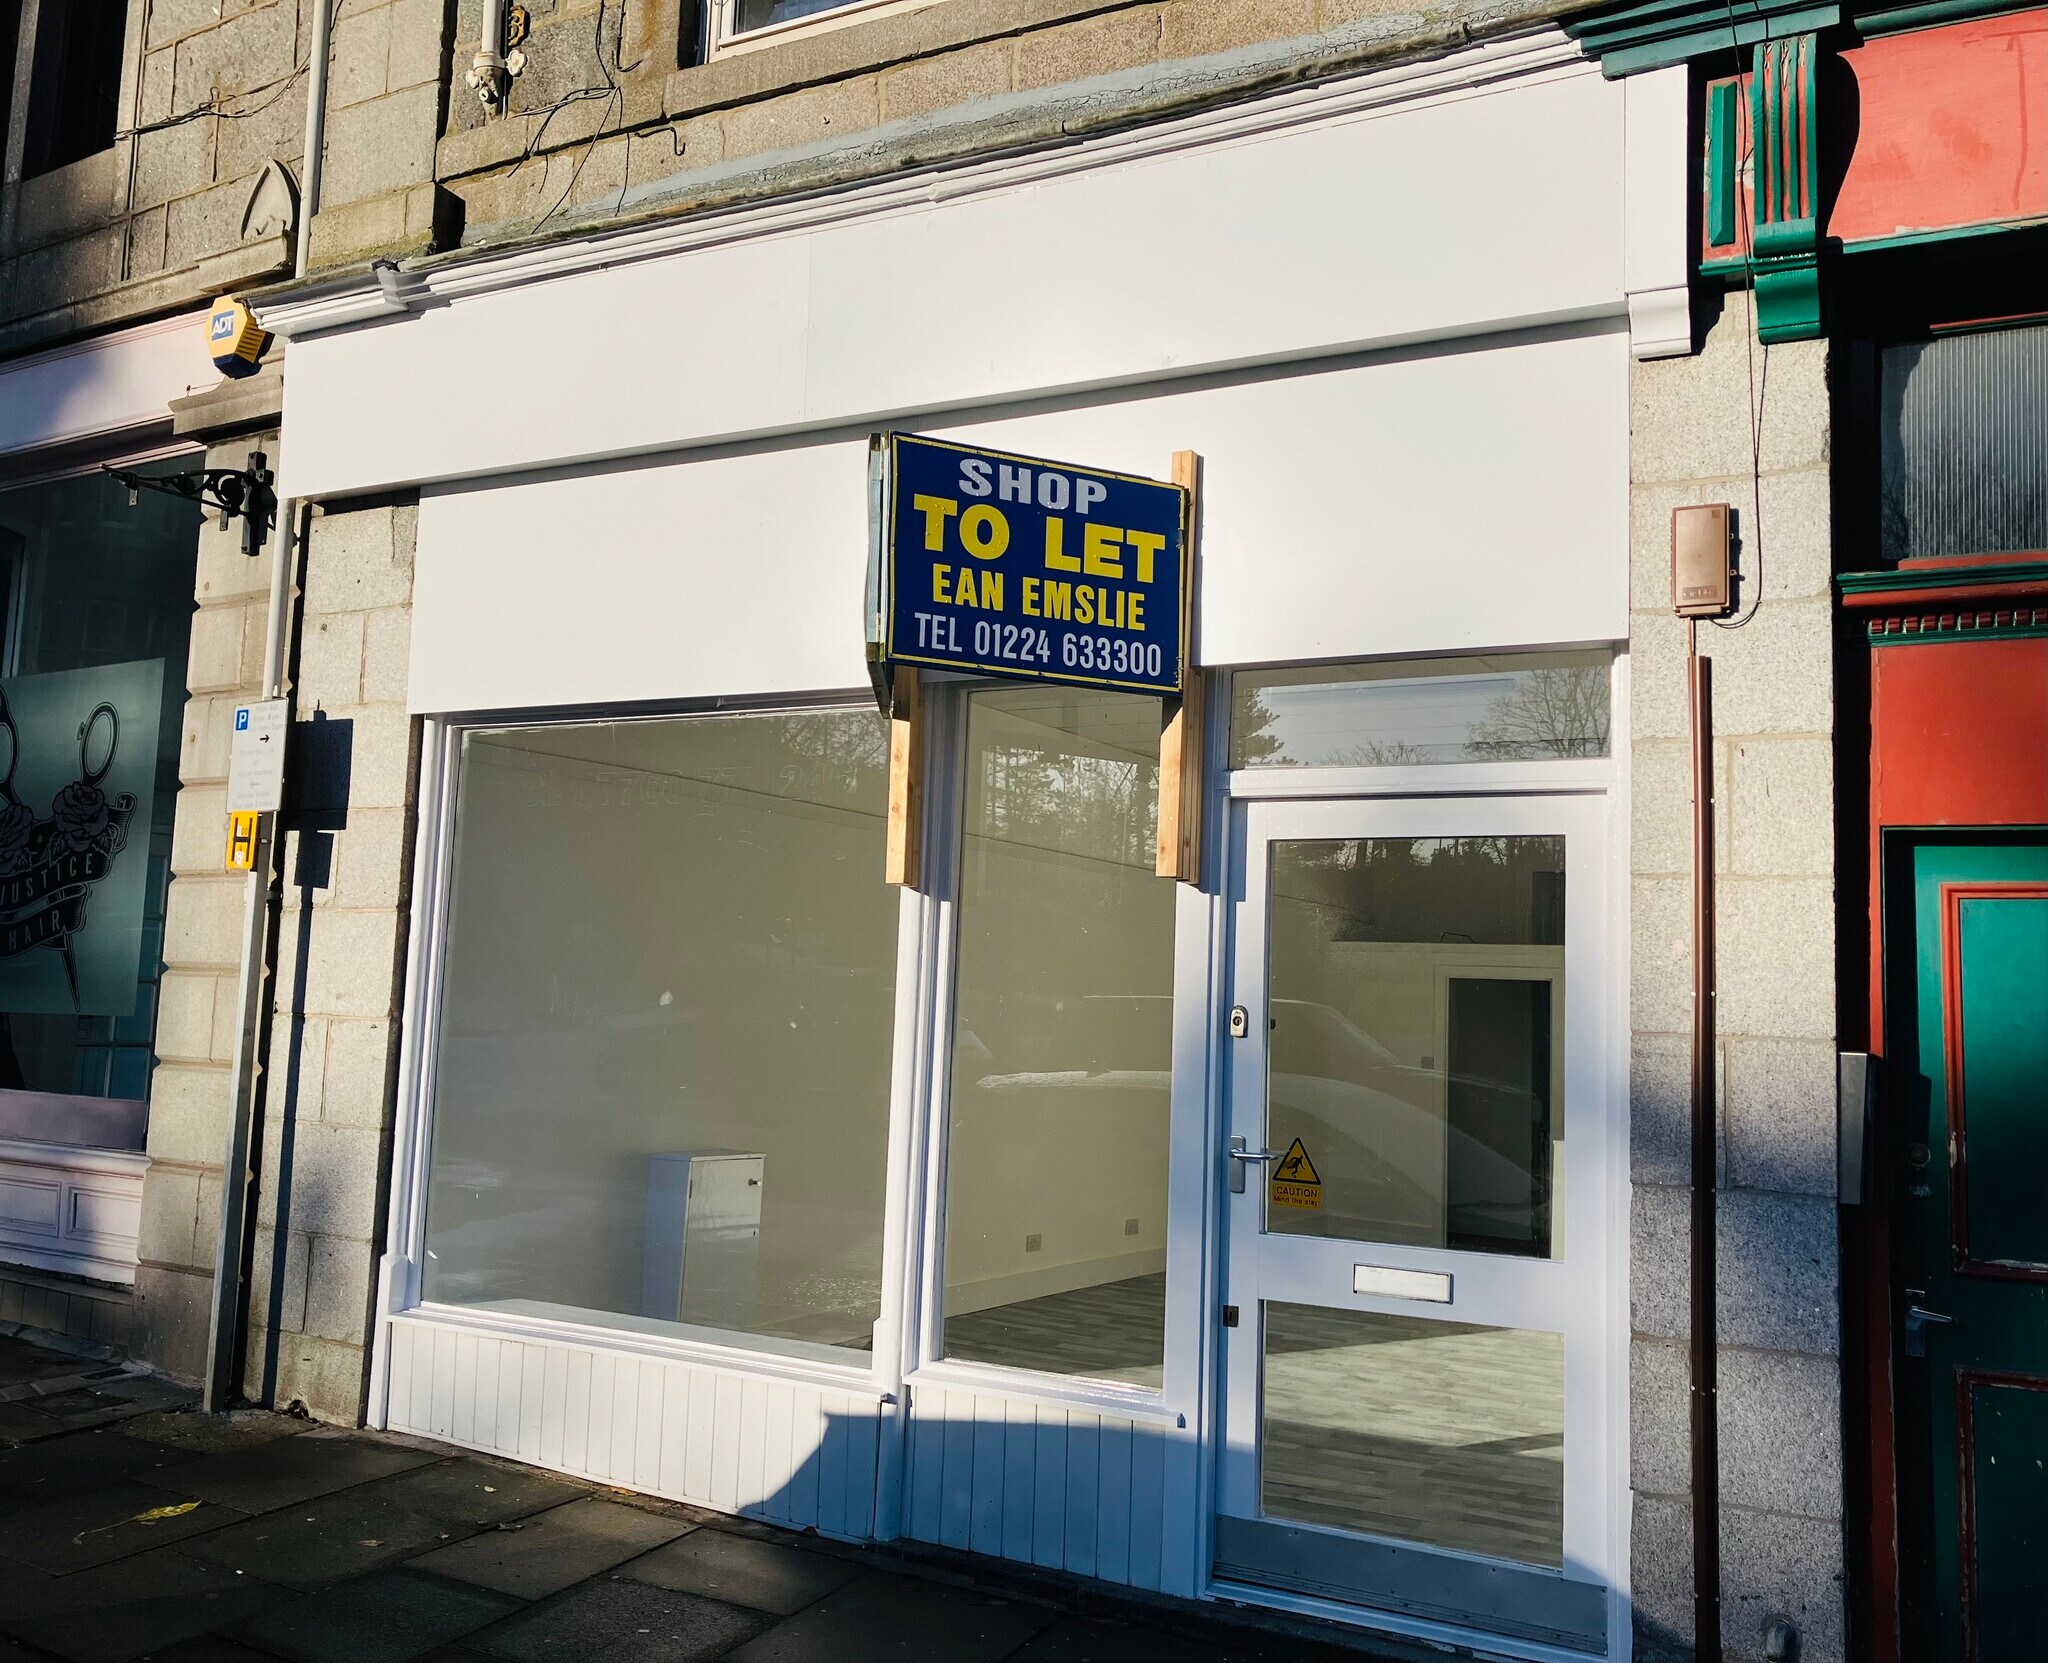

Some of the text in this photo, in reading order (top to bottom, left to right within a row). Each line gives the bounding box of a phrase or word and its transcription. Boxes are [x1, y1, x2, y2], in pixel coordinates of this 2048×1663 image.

[212, 317, 234, 334] ADT
[958, 457, 1108, 515] SHOP
[913, 493, 1166, 584] TO LET
[932, 562, 1146, 632] EAN EMSLIE
[914, 612, 1162, 677] TEL 01224 633300
[238, 711, 248, 729] P
[0, 853, 93, 905] JUSTICE
[9, 909, 60, 952] HAIR
[1273, 1195, 1290, 1203] Mind
[1276, 1186, 1318, 1198] CAUTION
